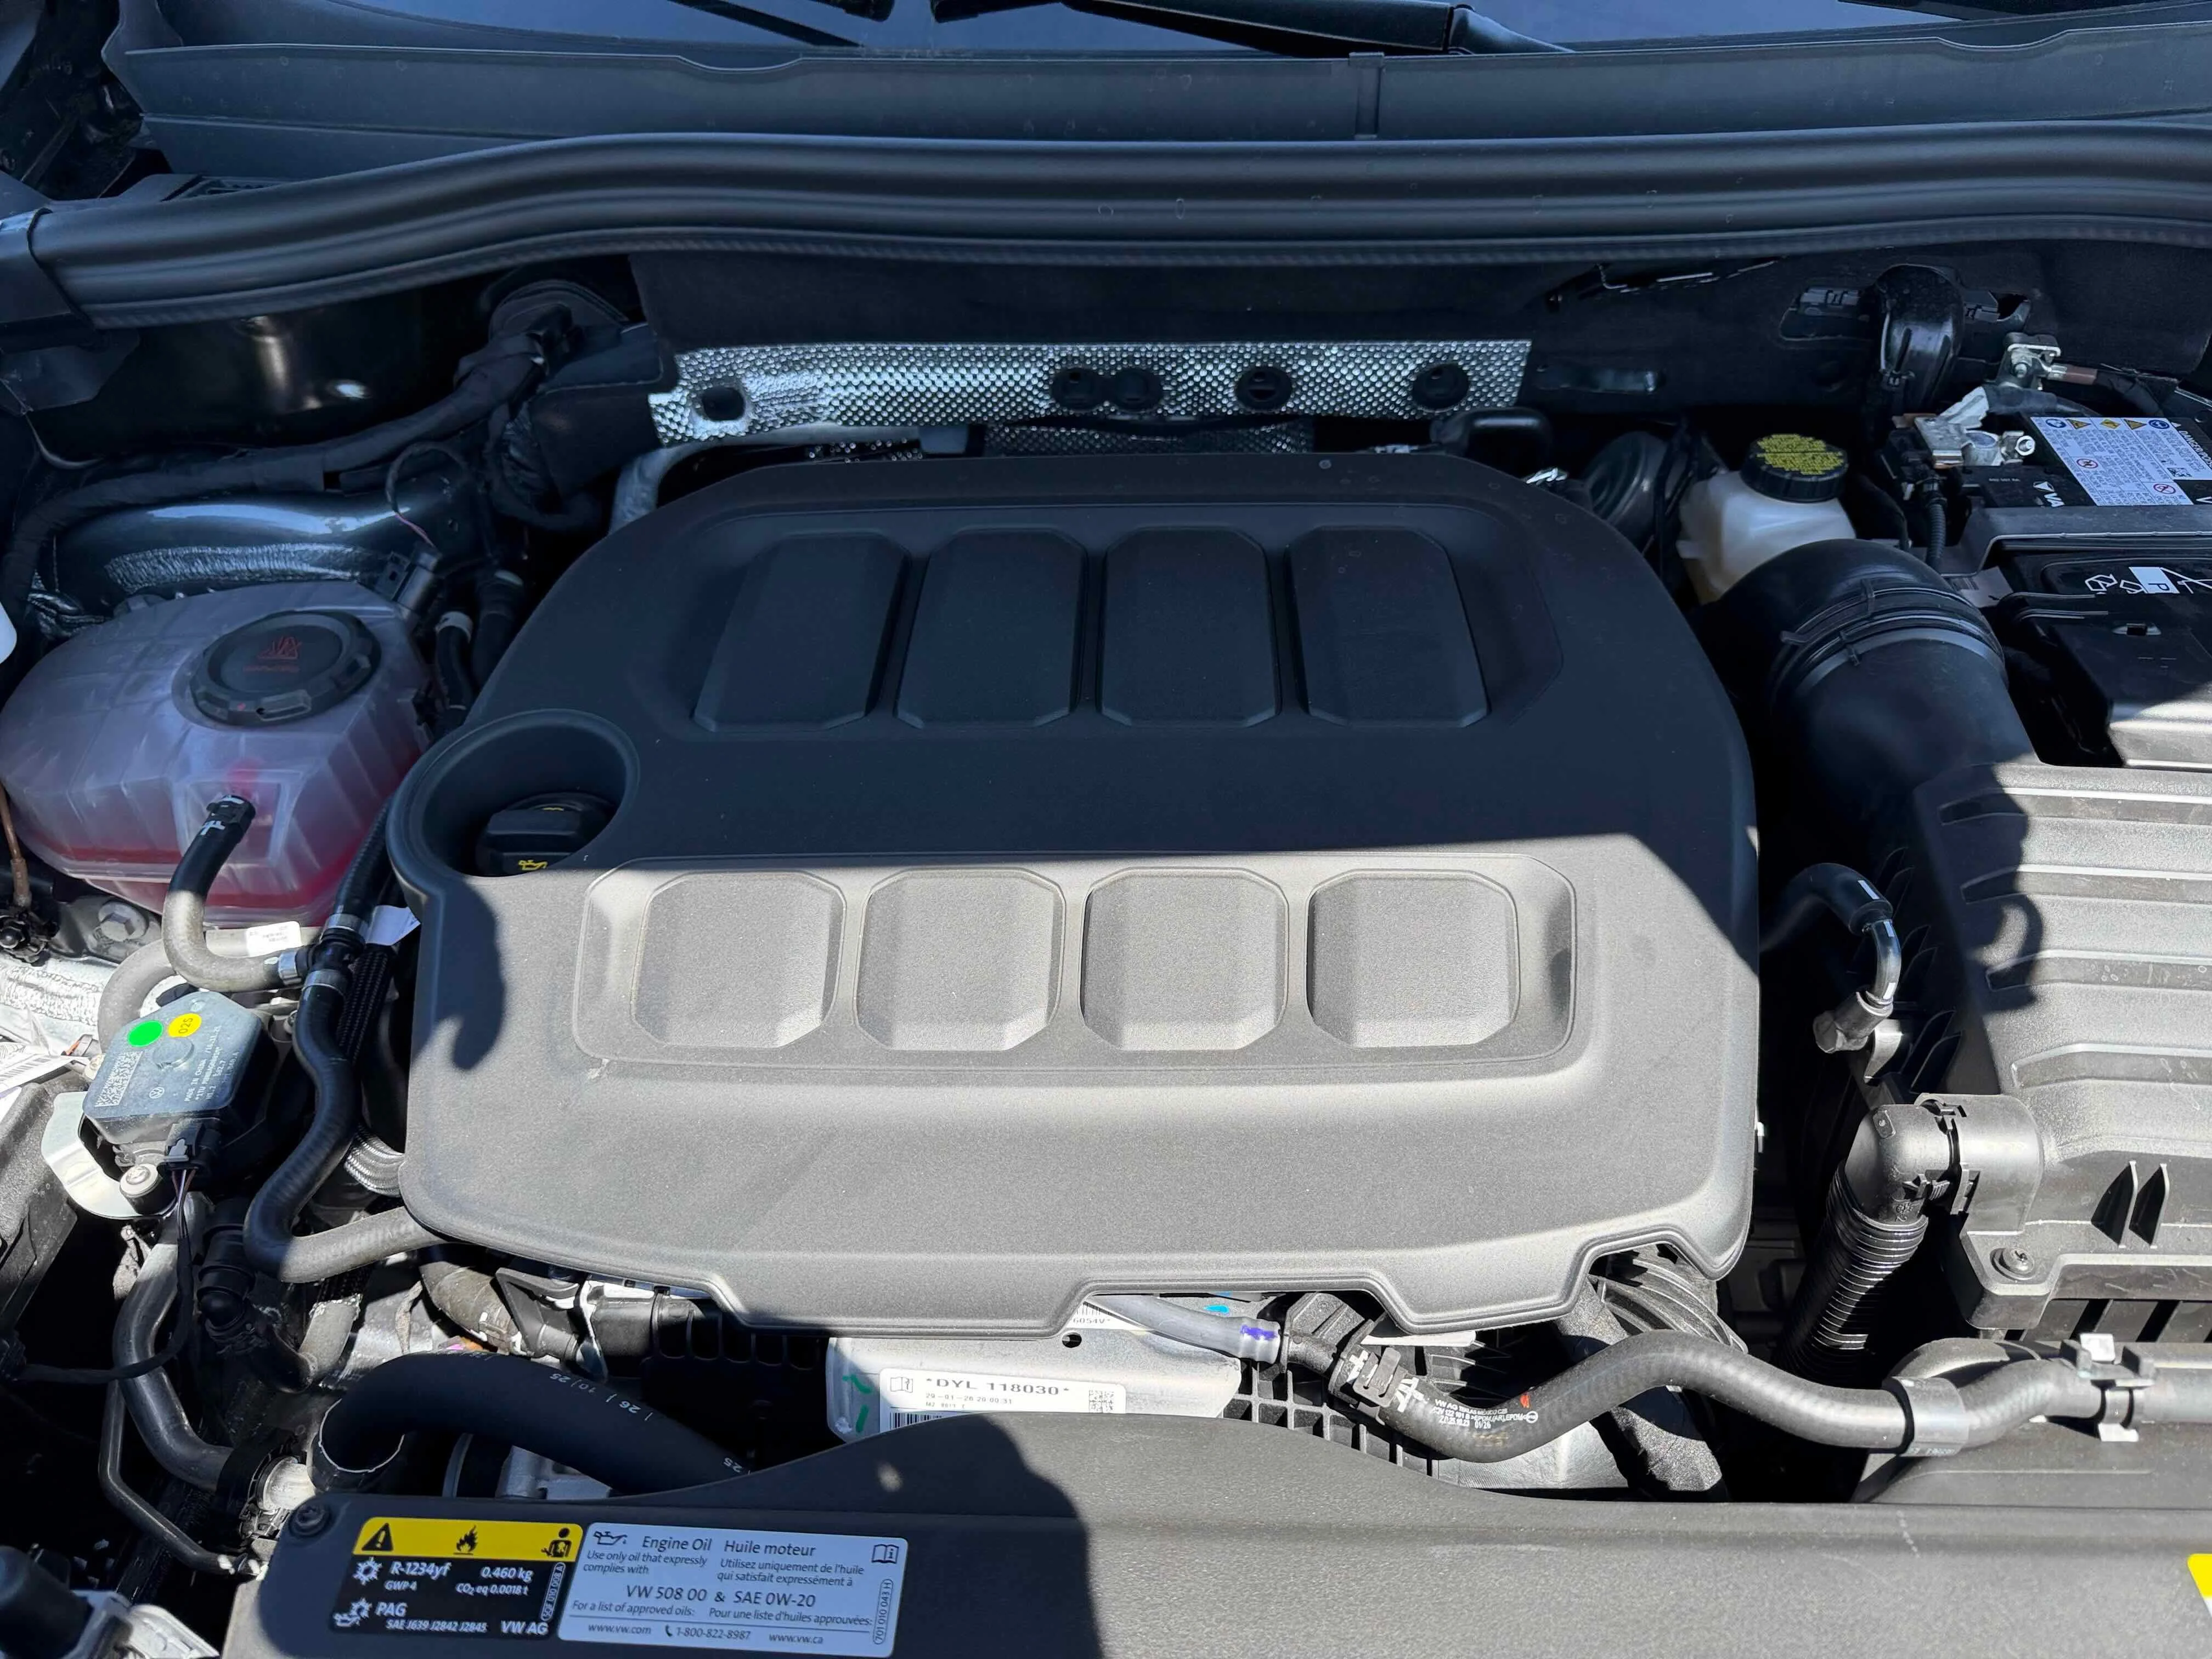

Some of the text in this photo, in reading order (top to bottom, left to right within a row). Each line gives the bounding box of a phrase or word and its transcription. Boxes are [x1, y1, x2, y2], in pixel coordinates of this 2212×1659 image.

[1435, 1399, 1447, 1407] VW
[1447, 1402, 1458, 1410] AG
[642, 1536, 713, 1552] Engine Oil
[724, 1540, 816, 1556] Huile moteur
[587, 1550, 708, 1567] Use only oil that expressly
[720, 1558, 865, 1575] Utilisez uniquement de l'huile
[390, 1561, 534, 1583] R-1234yf 0.460 kg
[583, 1563, 649, 1575] complies with
[716, 1570, 853, 1587] qui satisfait expressément à
[627, 1584, 816, 1608] VW 508 00 & SAE 0W-20
[375, 1601, 408, 1617] PAG
[572, 1600, 588, 1610] For
[598, 1601, 613, 1612] list
[614, 1602, 626, 1612] of
[627, 1604, 674, 1616] approved
[675, 1606, 696, 1616] oils:
[709, 1607, 873, 1627] Pour une liste d'huiles approuvées:
[877, 1609, 887, 1624] 010
[386, 1620, 407, 1630] SAE
[501, 1620, 549, 1635] VW AG
[588, 1623, 823, 1644] www.vw.com 1-800-822-8987 www.vw.ca
